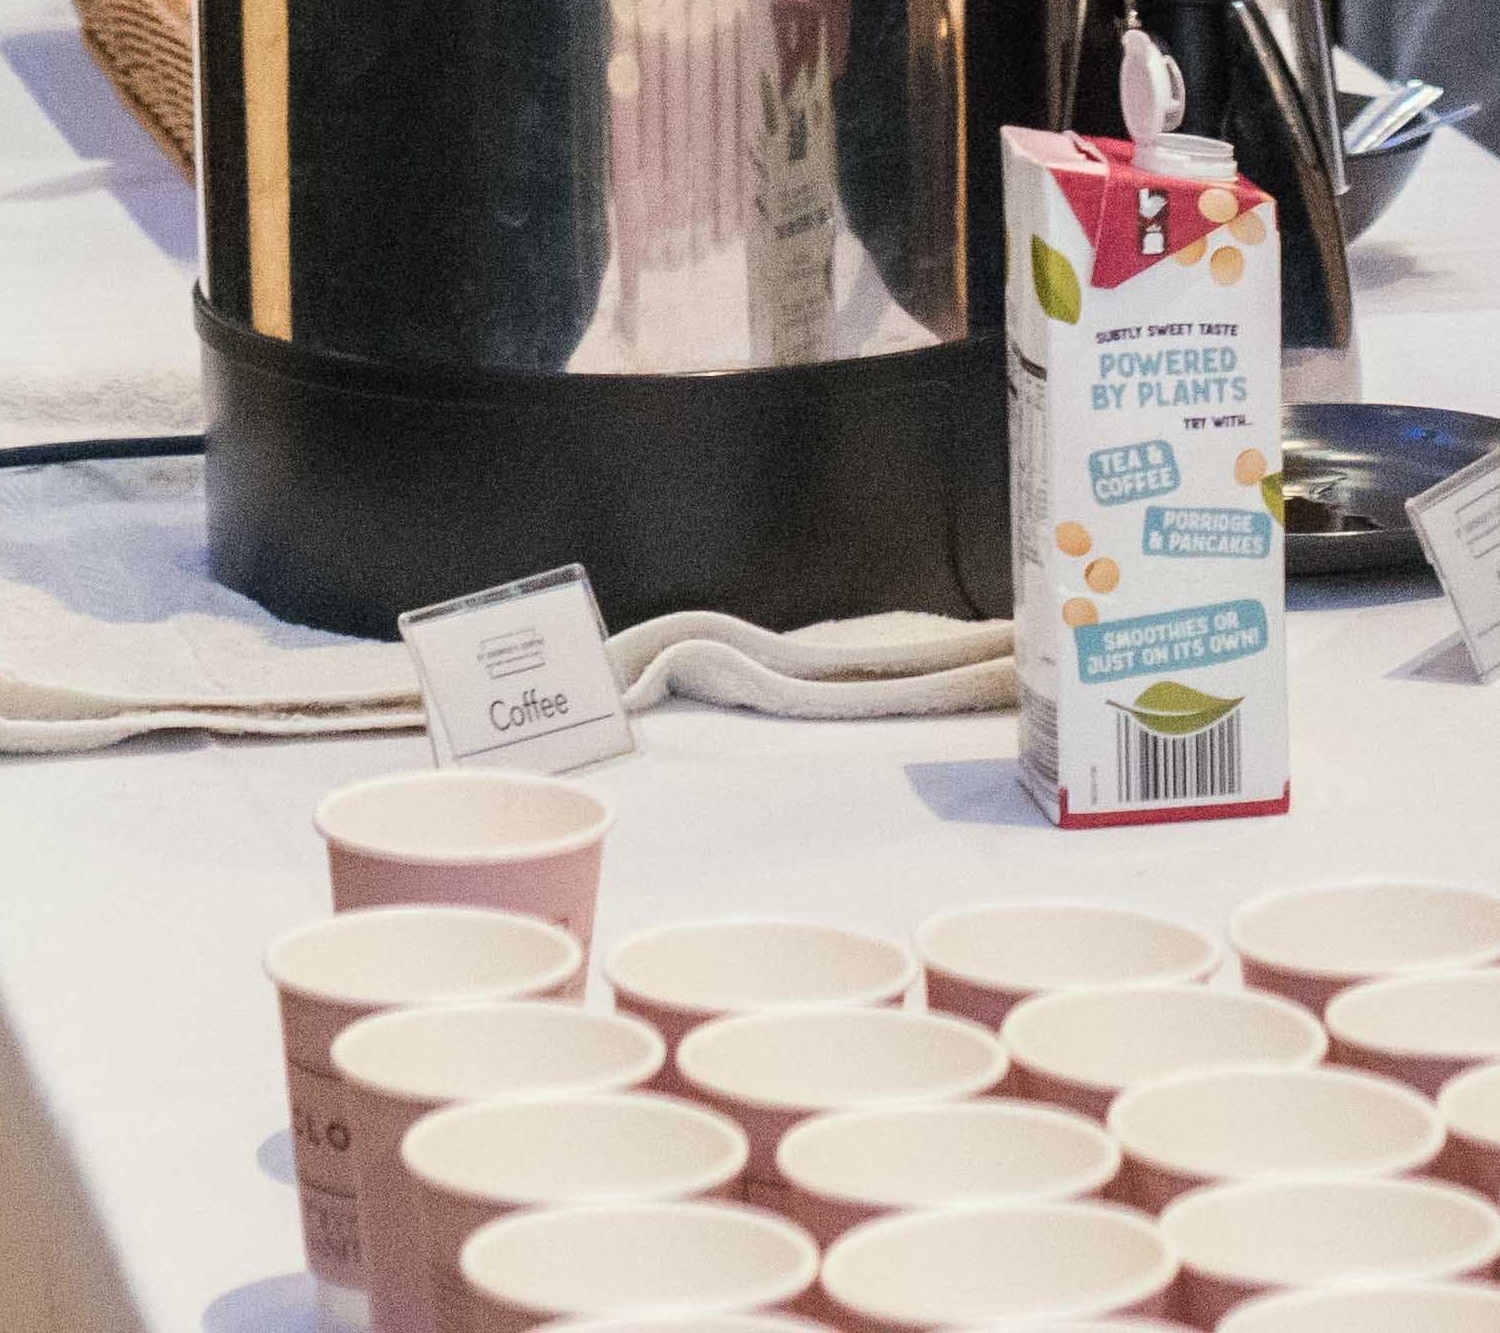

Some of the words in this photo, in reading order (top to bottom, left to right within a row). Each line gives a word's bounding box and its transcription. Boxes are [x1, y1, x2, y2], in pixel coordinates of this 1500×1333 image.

[1095, 326, 1142, 344] SUBTLY
[1148, 323, 1193, 337] SWEET
[1199, 323, 1240, 337] TASTE
[1098, 346, 1238, 380] POWERED
[1091, 383, 1127, 411] BY
[1137, 376, 1248, 408] PLANTS
[1183, 417, 1207, 430] TRY
[1097, 448, 1141, 475] TEA
[1147, 444, 1164, 465] &
[1095, 466, 1175, 500] COFFEE
[1162, 511, 1252, 533] PORRIDGE
[1147, 531, 1162, 550] &
[1169, 531, 1265, 555] PANCAKES
[1103, 615, 1209, 651] SMOOTHIES
[1214, 611, 1239, 631] OR
[1087, 650, 1135, 675] JUST
[1141, 645, 1169, 666] ON
[1173, 638, 1205, 661] ITS
[1209, 629, 1260, 654] OWN!
[488, 689, 572, 732] Coffee
